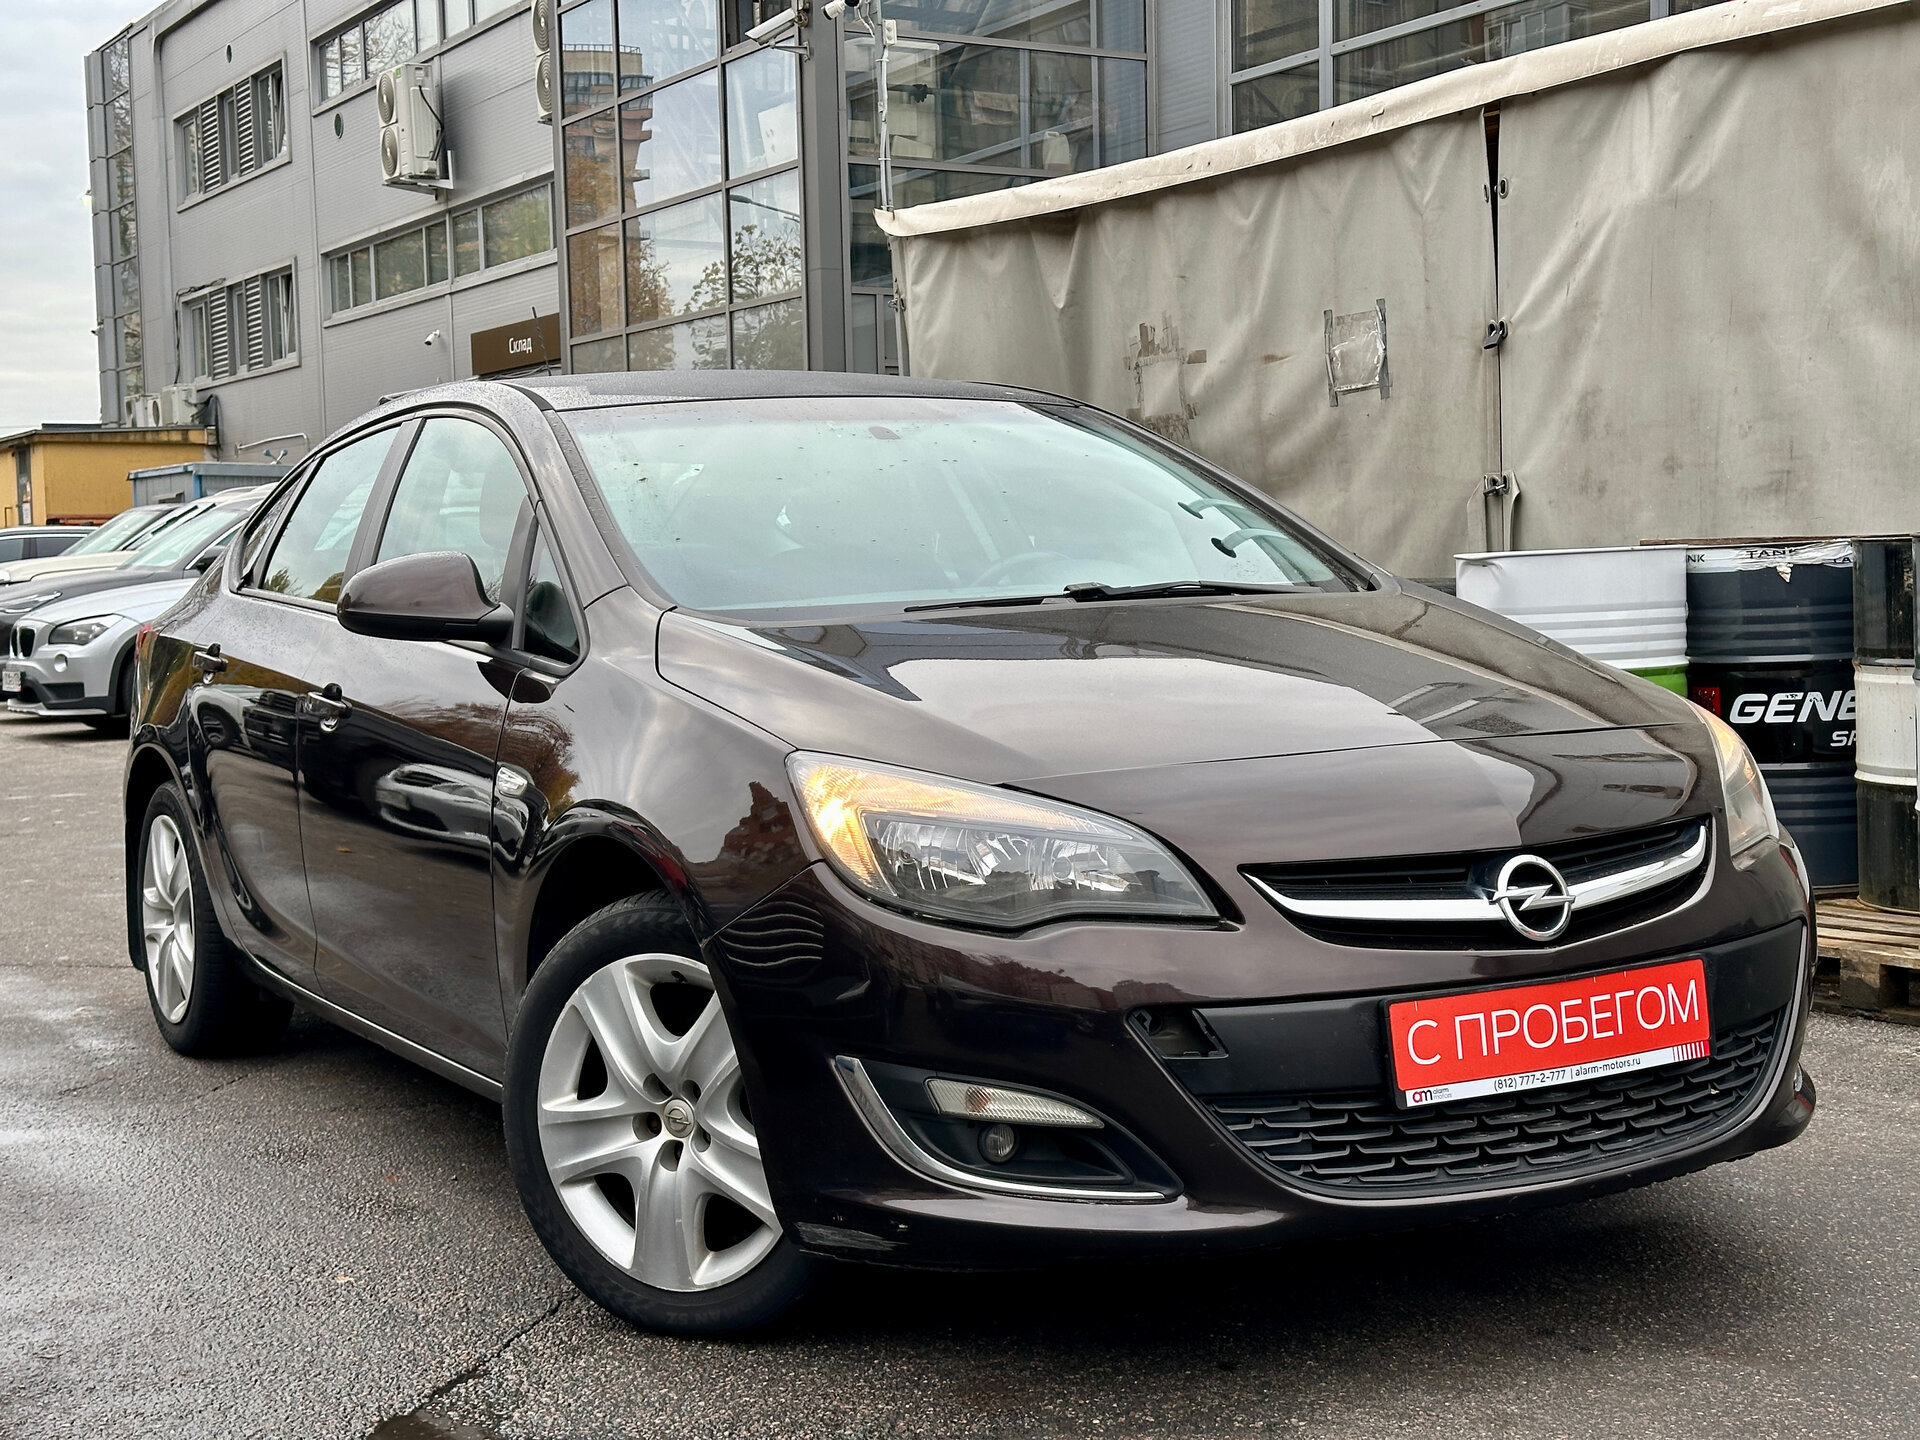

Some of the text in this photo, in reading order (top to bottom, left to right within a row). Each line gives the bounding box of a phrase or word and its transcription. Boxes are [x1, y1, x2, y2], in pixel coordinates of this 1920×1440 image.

[508, 337, 532, 353] Склад
[1407, 979, 1700, 1065] С ПРОБЕГОМ
[1493, 1057, 1641, 1092] (812) 777-2-777 alarm-motors.ru
